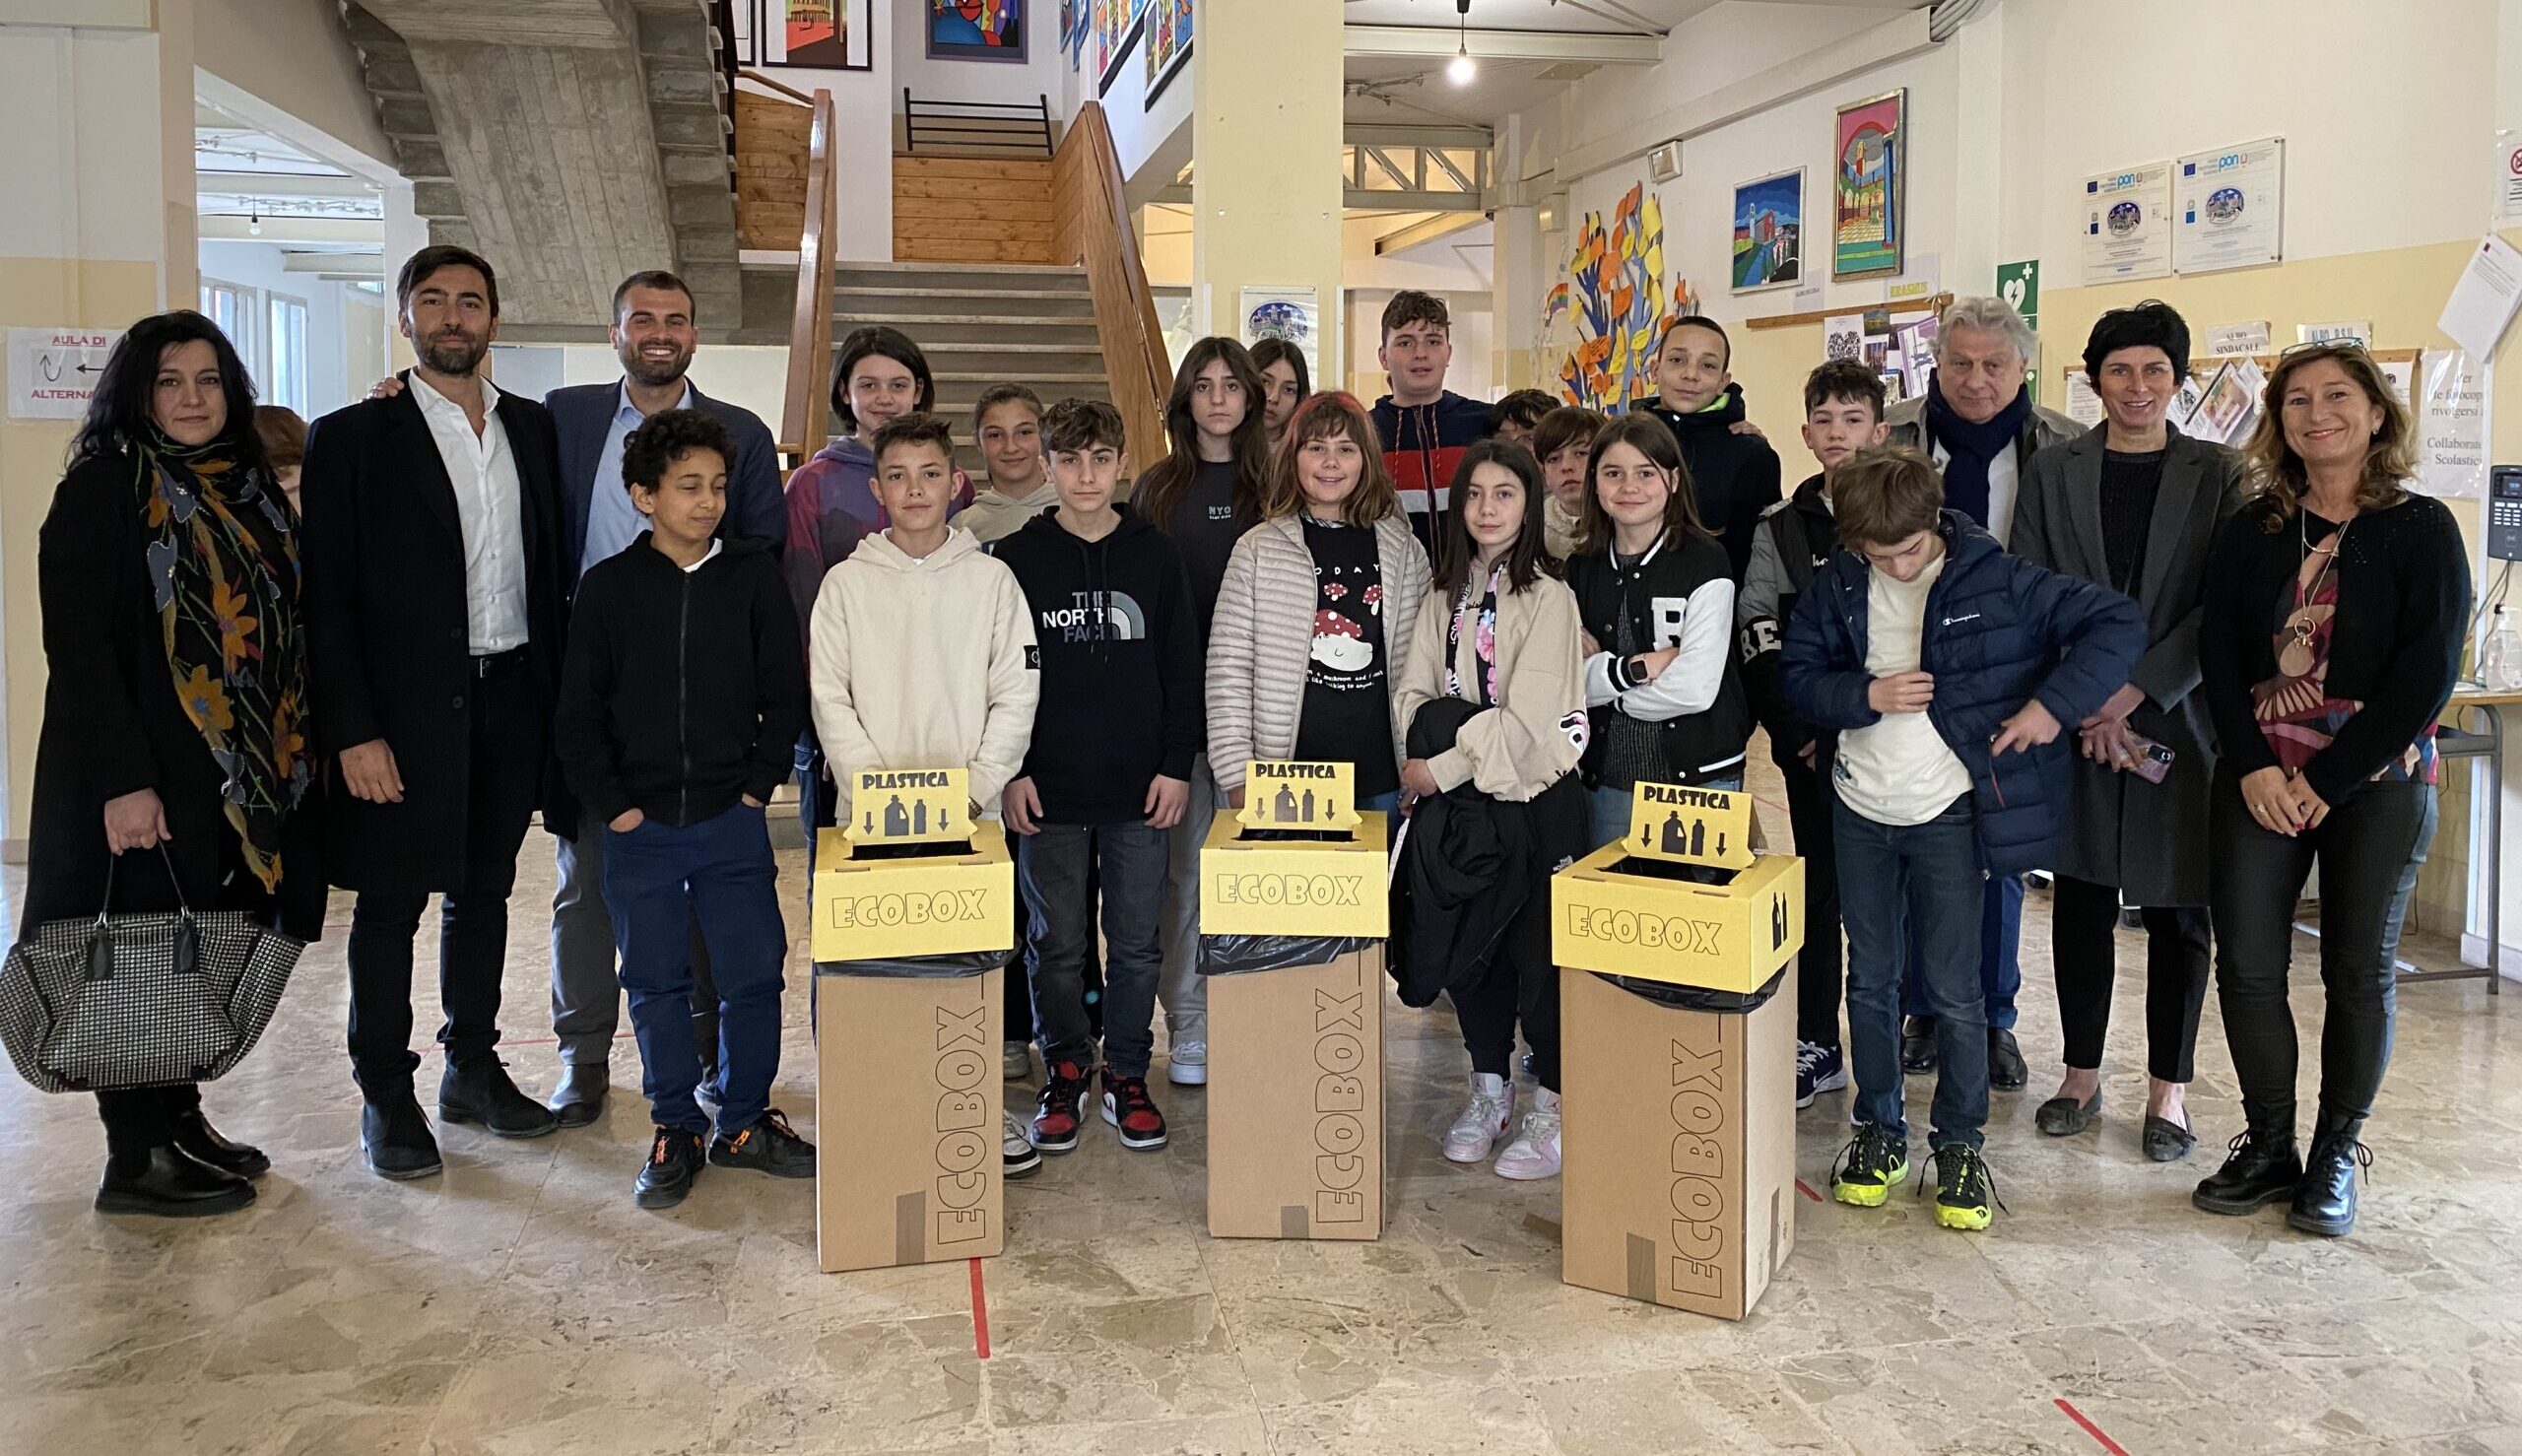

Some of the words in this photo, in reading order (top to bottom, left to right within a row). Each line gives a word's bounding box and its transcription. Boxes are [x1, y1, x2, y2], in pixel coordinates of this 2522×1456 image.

[2219, 154, 2239, 172] pon
[2117, 173, 2136, 190] pon
[52, 336, 89, 346] AULA
[93, 336, 106, 346] DI
[2216, 343, 2260, 355] SINDACALE
[862, 771, 950, 790] PLASTICA
[1255, 763, 1336, 779] PLASTICA
[1643, 785, 1730, 811] PLASTICA
[1217, 874, 1362, 906] ECOBOX
[831, 889, 987, 929] ECOBOX
[1568, 903, 1722, 956] ECOBOX
[1313, 988, 1364, 1224] ECOBOX
[935, 1006, 987, 1245] ECOBOX
[1670, 1038, 1724, 1299] ECOBOX
